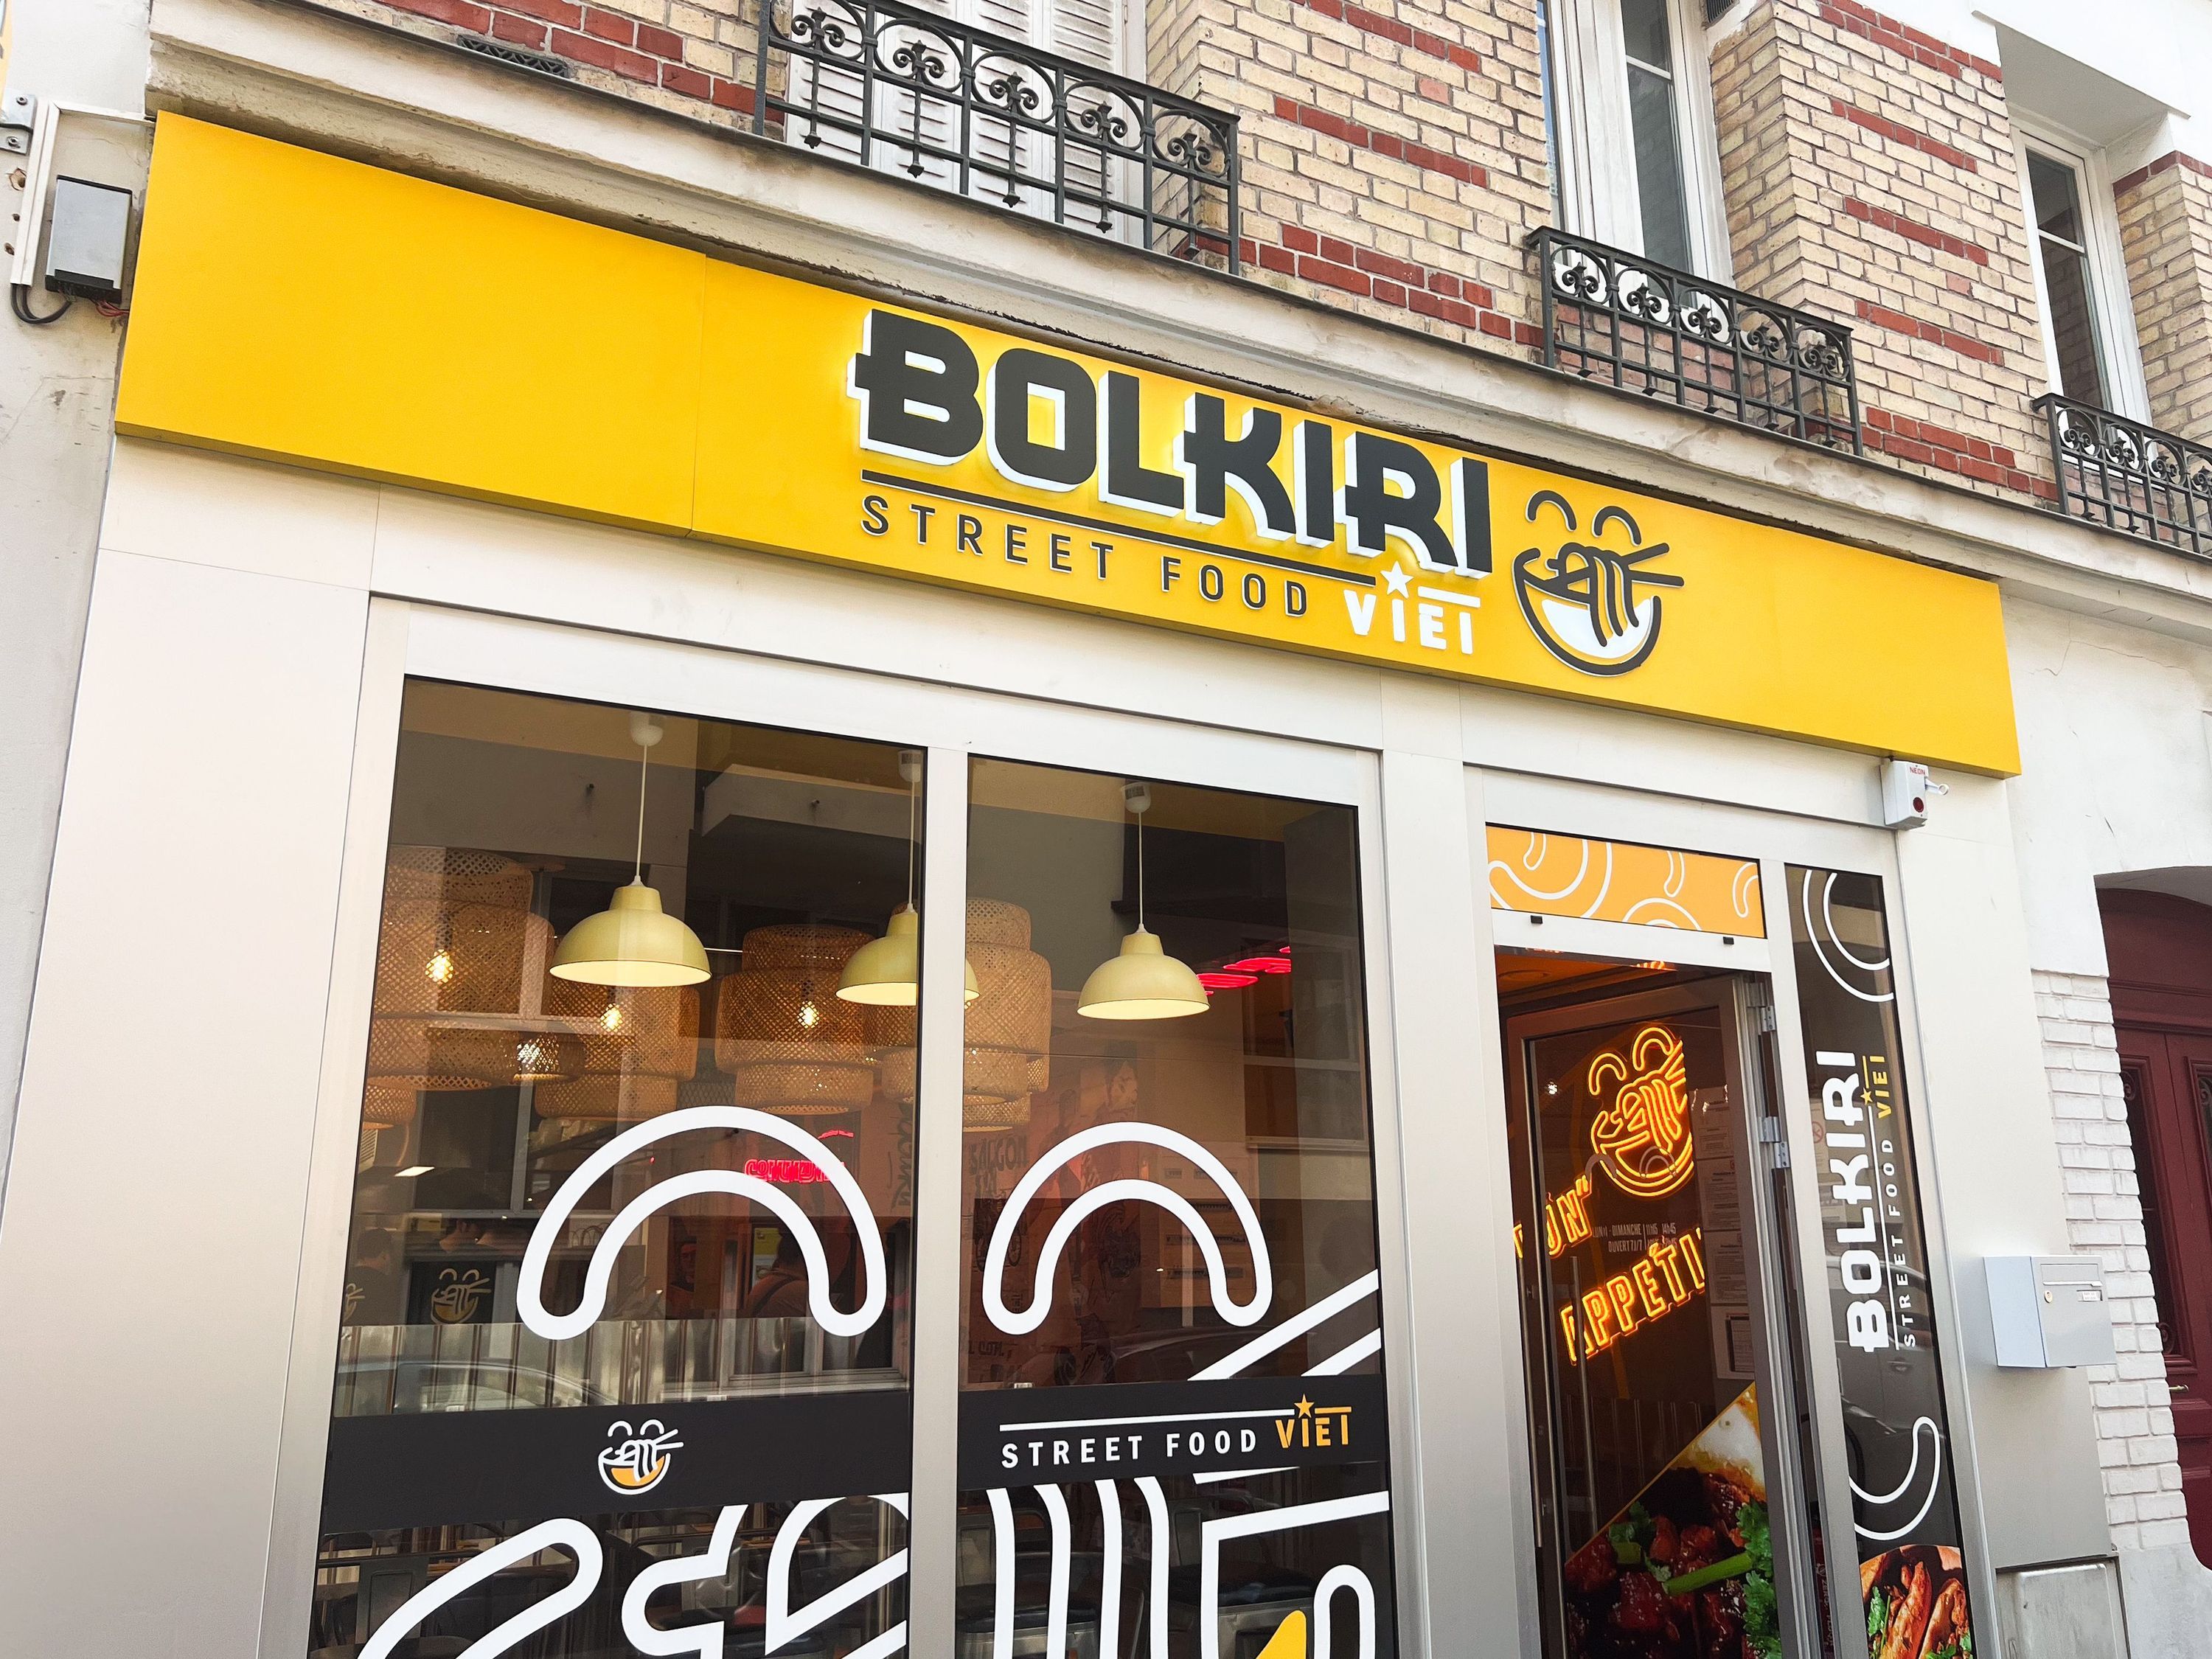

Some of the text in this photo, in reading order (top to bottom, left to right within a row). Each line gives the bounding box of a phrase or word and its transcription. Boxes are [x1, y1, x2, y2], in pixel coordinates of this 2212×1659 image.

[848, 308, 1493, 579] BOLKIRI
[861, 495, 1481, 655] STREET FOOD VIET
[1910, 767, 1925, 776] NEON
[1607, 1240, 1630, 1253] OUVERT
[1611, 1222, 1642, 1237] DIMANCHE
[1815, 1051, 1890, 1353] BOLKIRI
[1863, 1056, 1916, 1348] STREET FOOD VIET
[1001, 1406, 1352, 1470] STREET FOOD VIET
